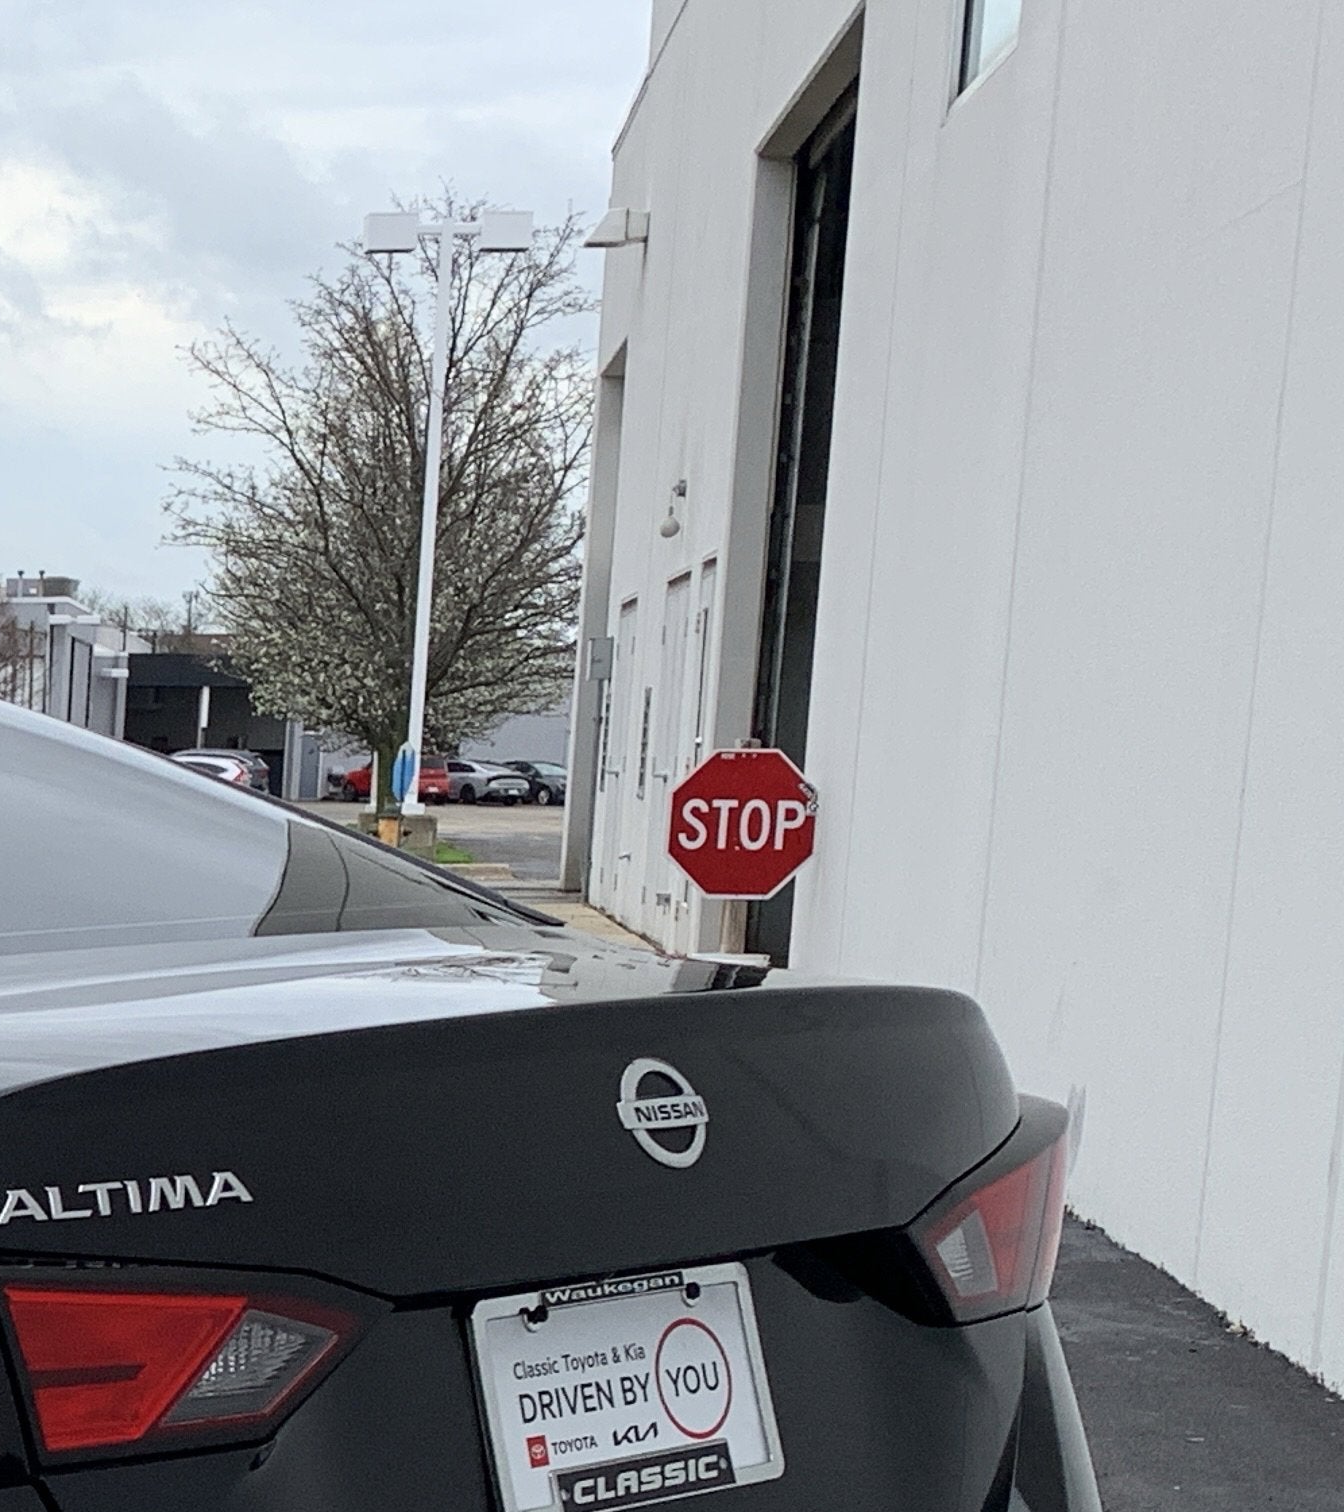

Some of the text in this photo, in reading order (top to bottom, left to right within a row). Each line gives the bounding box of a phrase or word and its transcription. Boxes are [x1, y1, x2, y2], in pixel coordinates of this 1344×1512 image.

[678, 798, 807, 850] STOP
[634, 1101, 705, 1123] NISSAN
[545, 1274, 680, 1305] Waukegan
[513, 1342, 646, 1380] Classic Toyota & Kia
[518, 1361, 720, 1424] DRIVEN BY YOU
[551, 1435, 599, 1455] TOYOTA
[572, 1454, 720, 1505] CLASSIC
